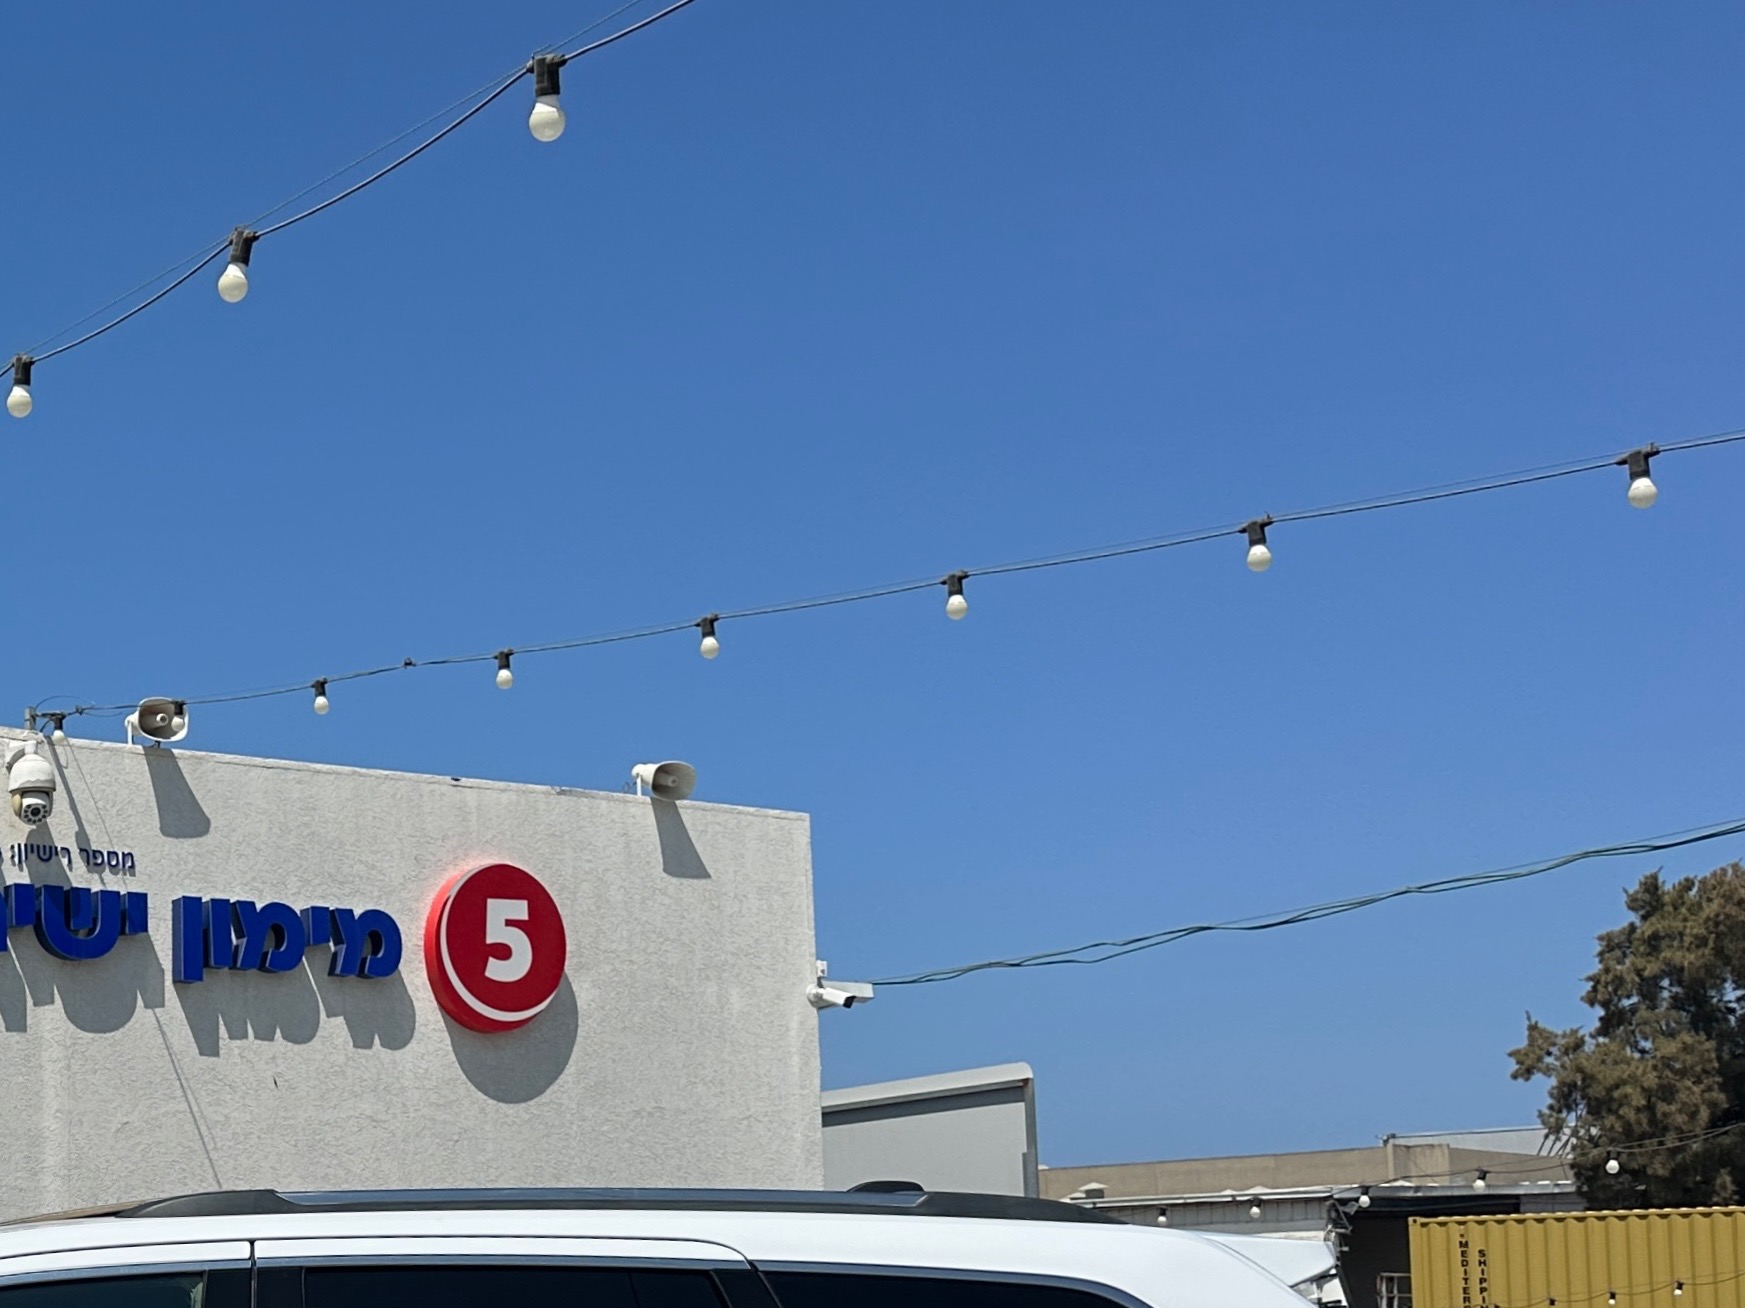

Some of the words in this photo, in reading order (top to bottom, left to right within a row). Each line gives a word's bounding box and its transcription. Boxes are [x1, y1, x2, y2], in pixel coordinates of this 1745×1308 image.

[78, 847, 136, 869] מספר
[171, 895, 403, 984] מימון
[484, 898, 533, 983] 5
